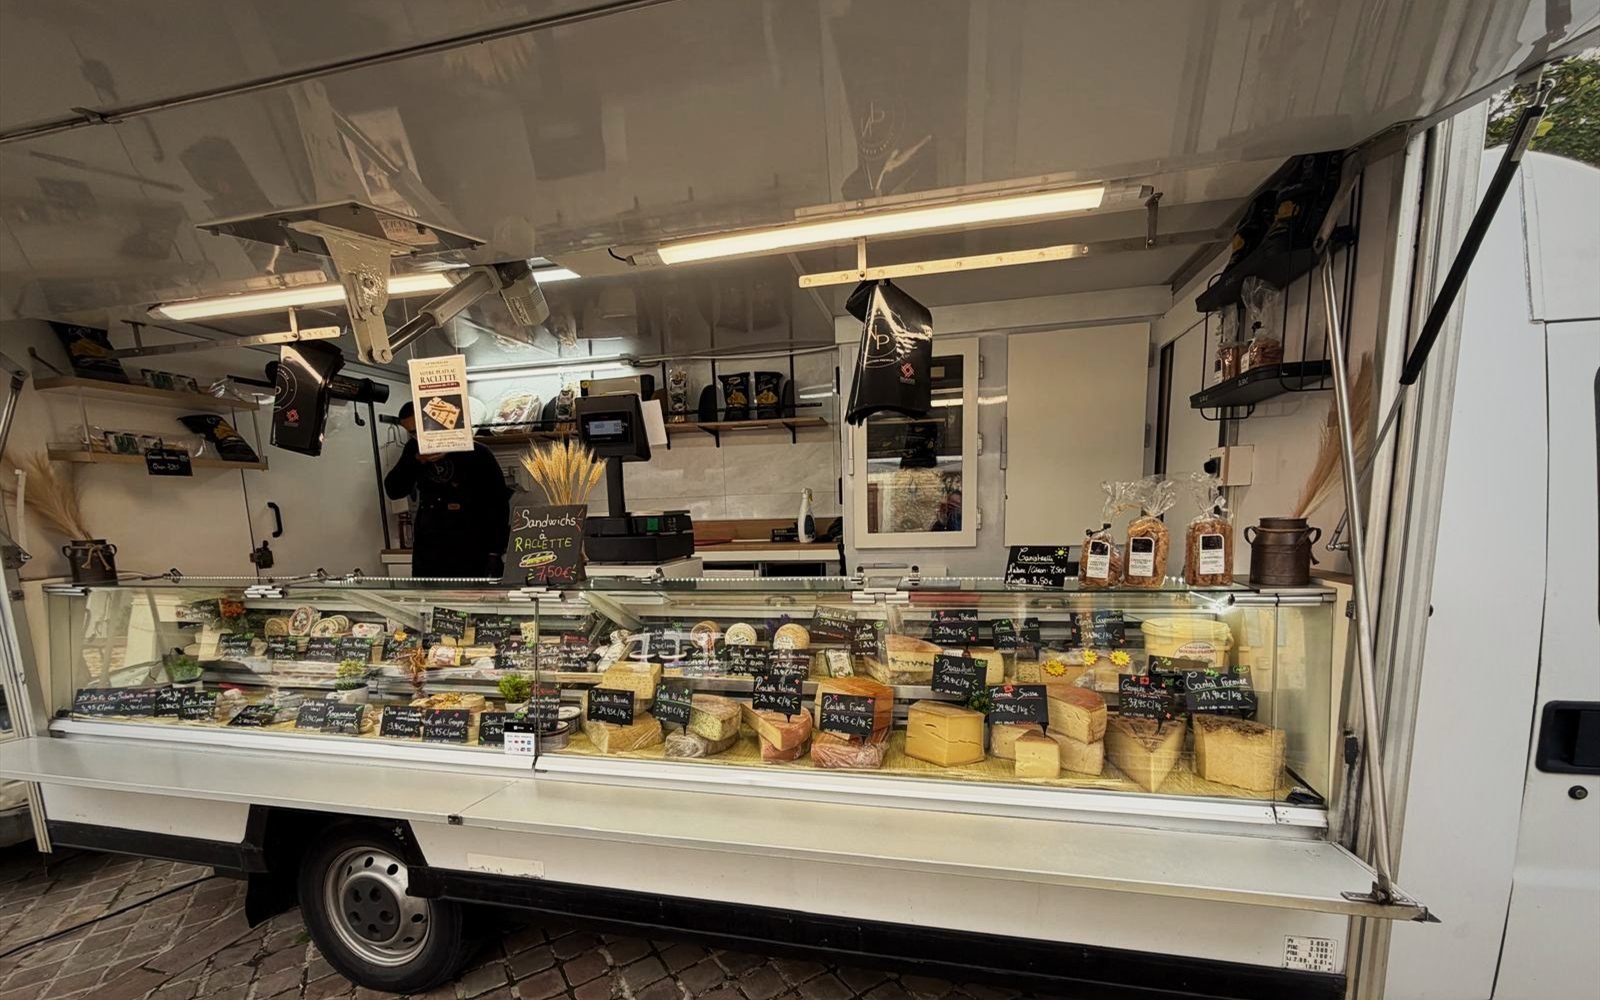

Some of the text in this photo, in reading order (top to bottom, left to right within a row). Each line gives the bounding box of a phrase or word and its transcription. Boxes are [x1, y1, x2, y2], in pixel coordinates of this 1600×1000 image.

[420, 374, 457, 383] RACLETTE
[512, 509, 576, 532] Sandwichs
[539, 529, 547, 540] à
[514, 536, 573, 552] RACLETTE
[535, 565, 573, 582] 7,50€
[1186, 671, 1217, 692] Cantal
[1220, 676, 1248, 688] Fermier
[1016, 687, 1040, 702] Suisse
